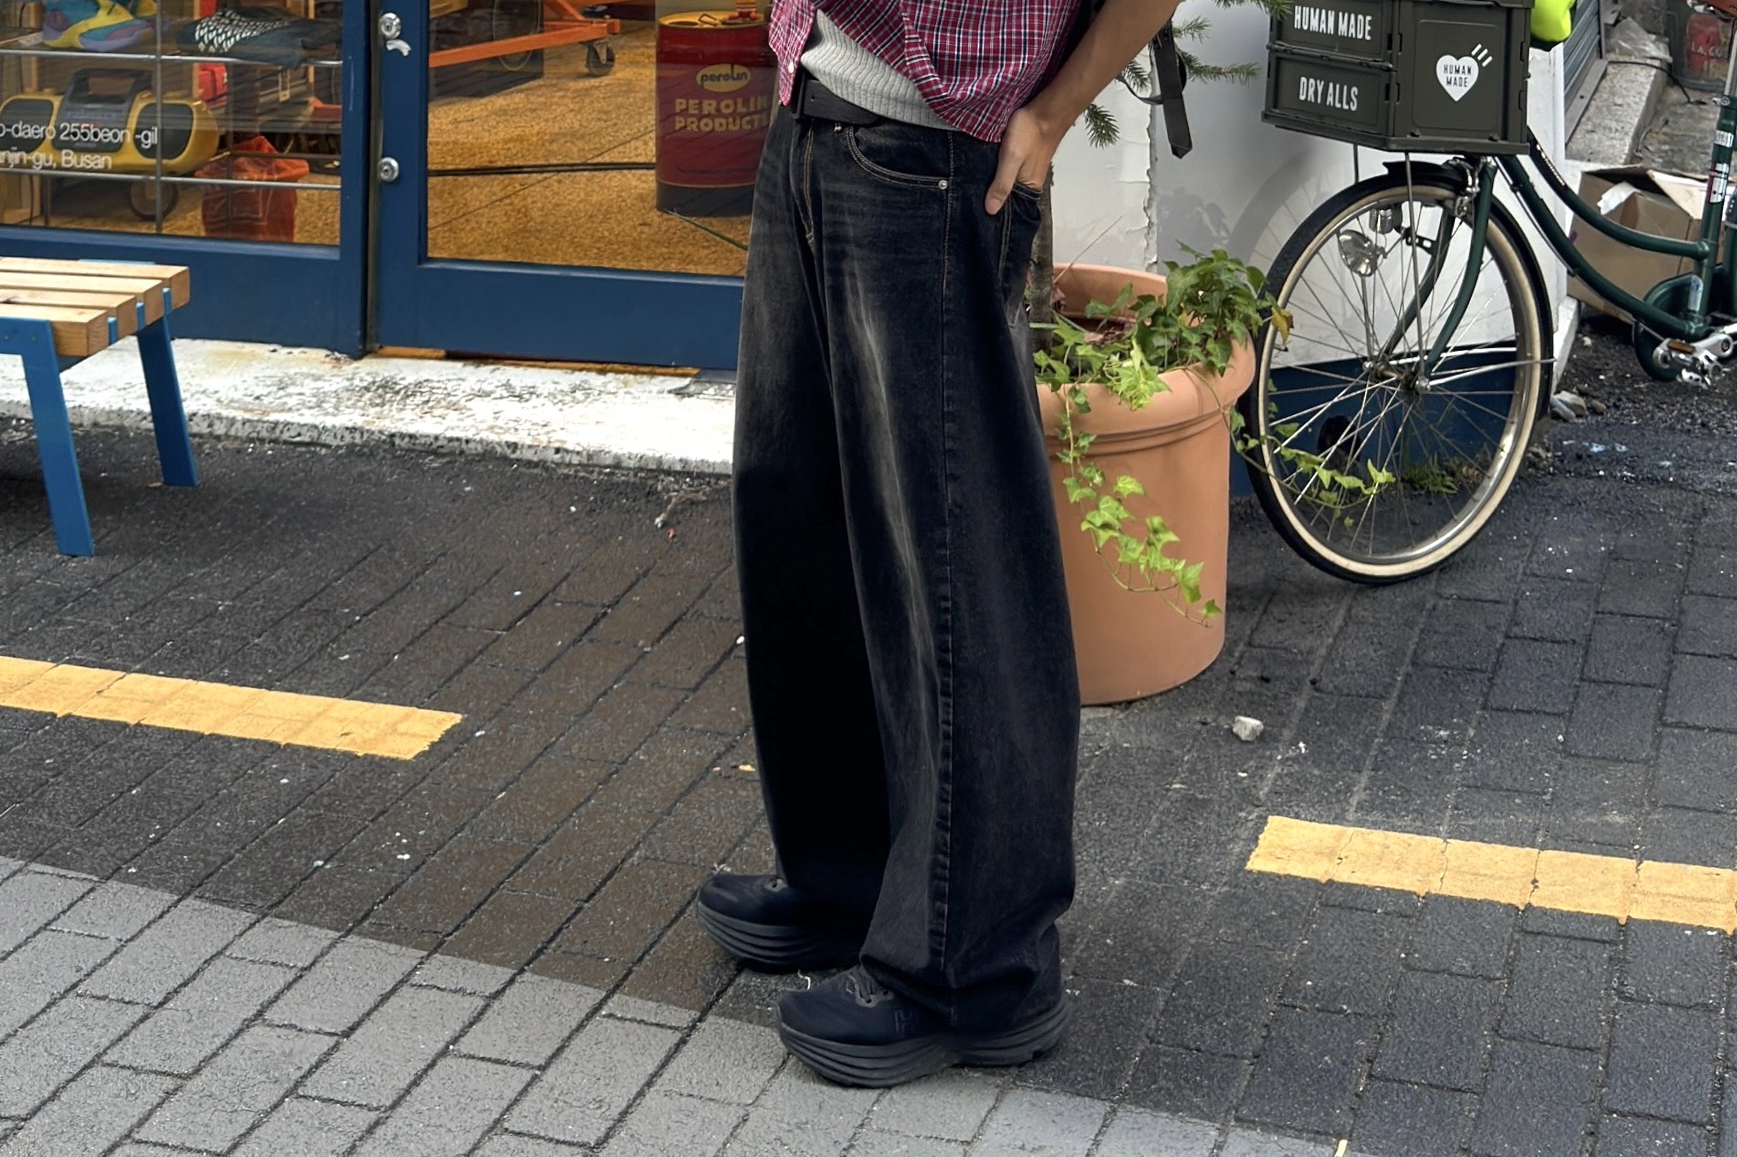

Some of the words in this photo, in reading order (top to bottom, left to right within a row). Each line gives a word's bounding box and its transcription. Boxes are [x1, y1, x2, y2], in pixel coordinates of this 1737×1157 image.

[1294, 5, 1335, 35] HUMAN
[1338, 11, 1373, 41] MADE
[700, 63, 748, 90] perolin
[1443, 63, 1472, 75] HUMAN
[1446, 76, 1468, 88] MADE
[1299, 76, 1325, 104] DRY
[1326, 81, 1359, 111] ALLS
[674, 95, 768, 116] PEROLIN
[61, 149, 113, 170] Busan
